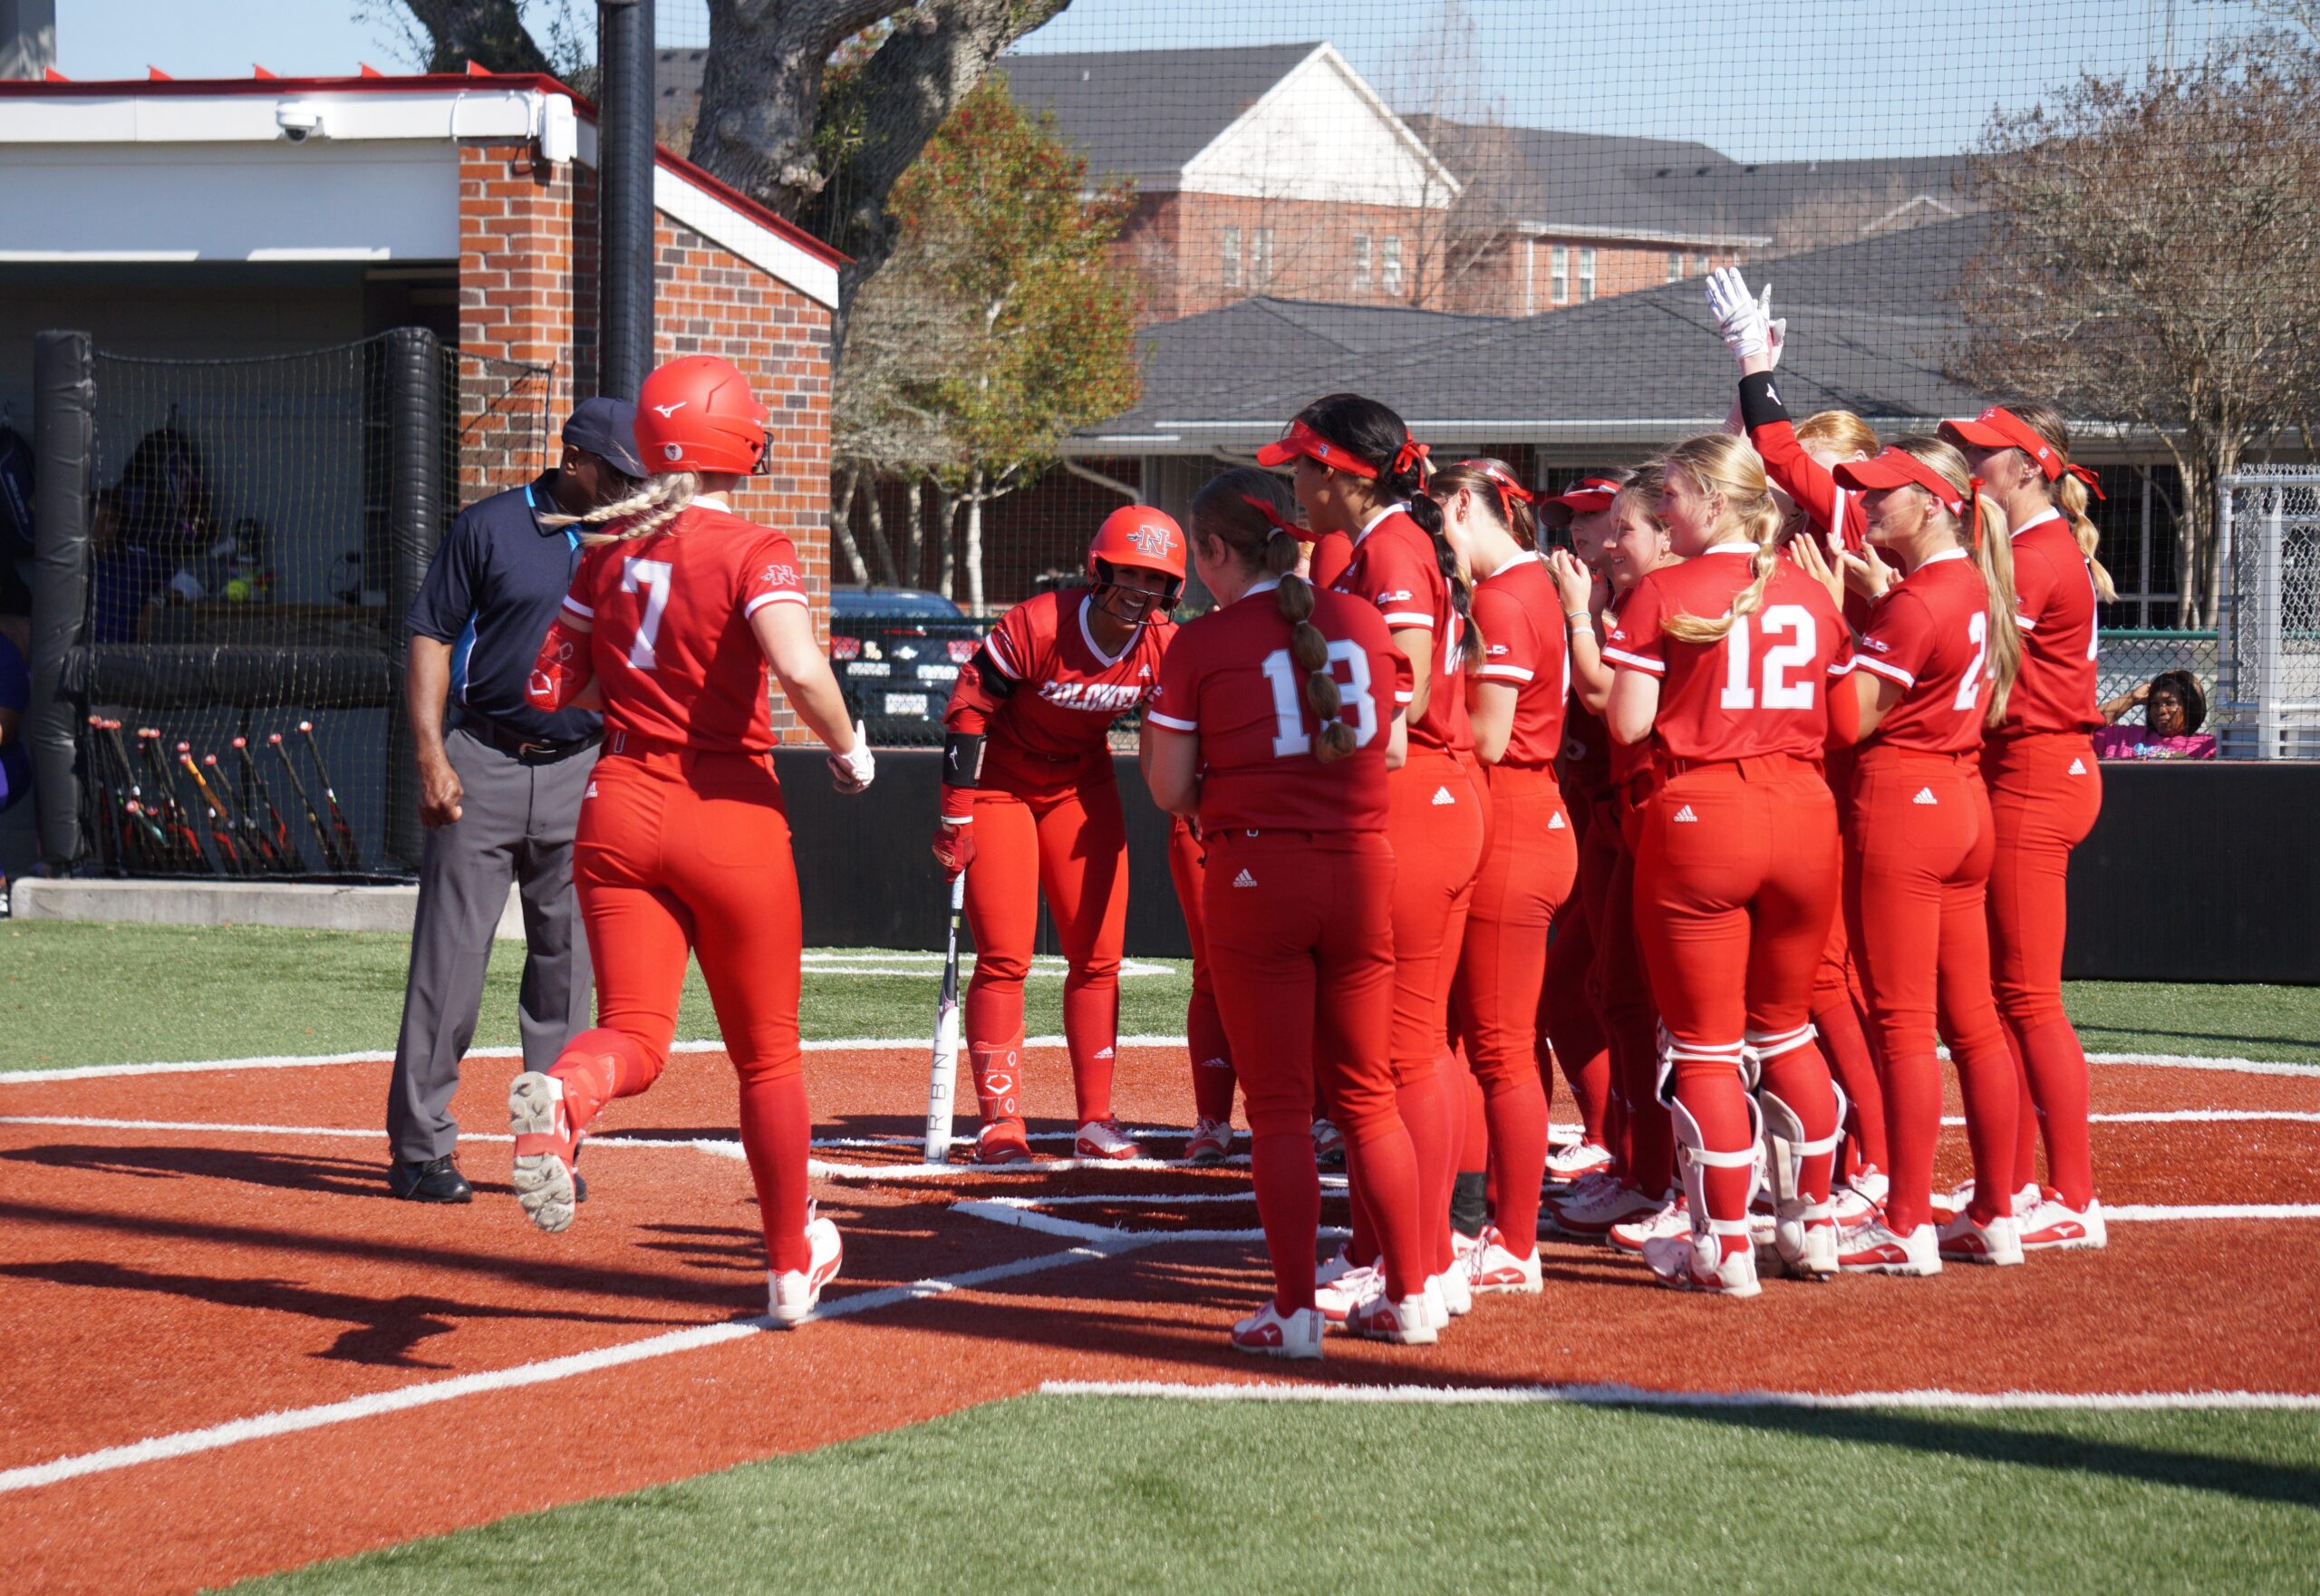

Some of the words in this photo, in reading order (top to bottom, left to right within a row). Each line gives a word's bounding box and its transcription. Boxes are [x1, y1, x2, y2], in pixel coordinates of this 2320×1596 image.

[621, 556, 673, 670] 7
[1720, 604, 1817, 711] 12
[1261, 638, 1378, 759] 13
